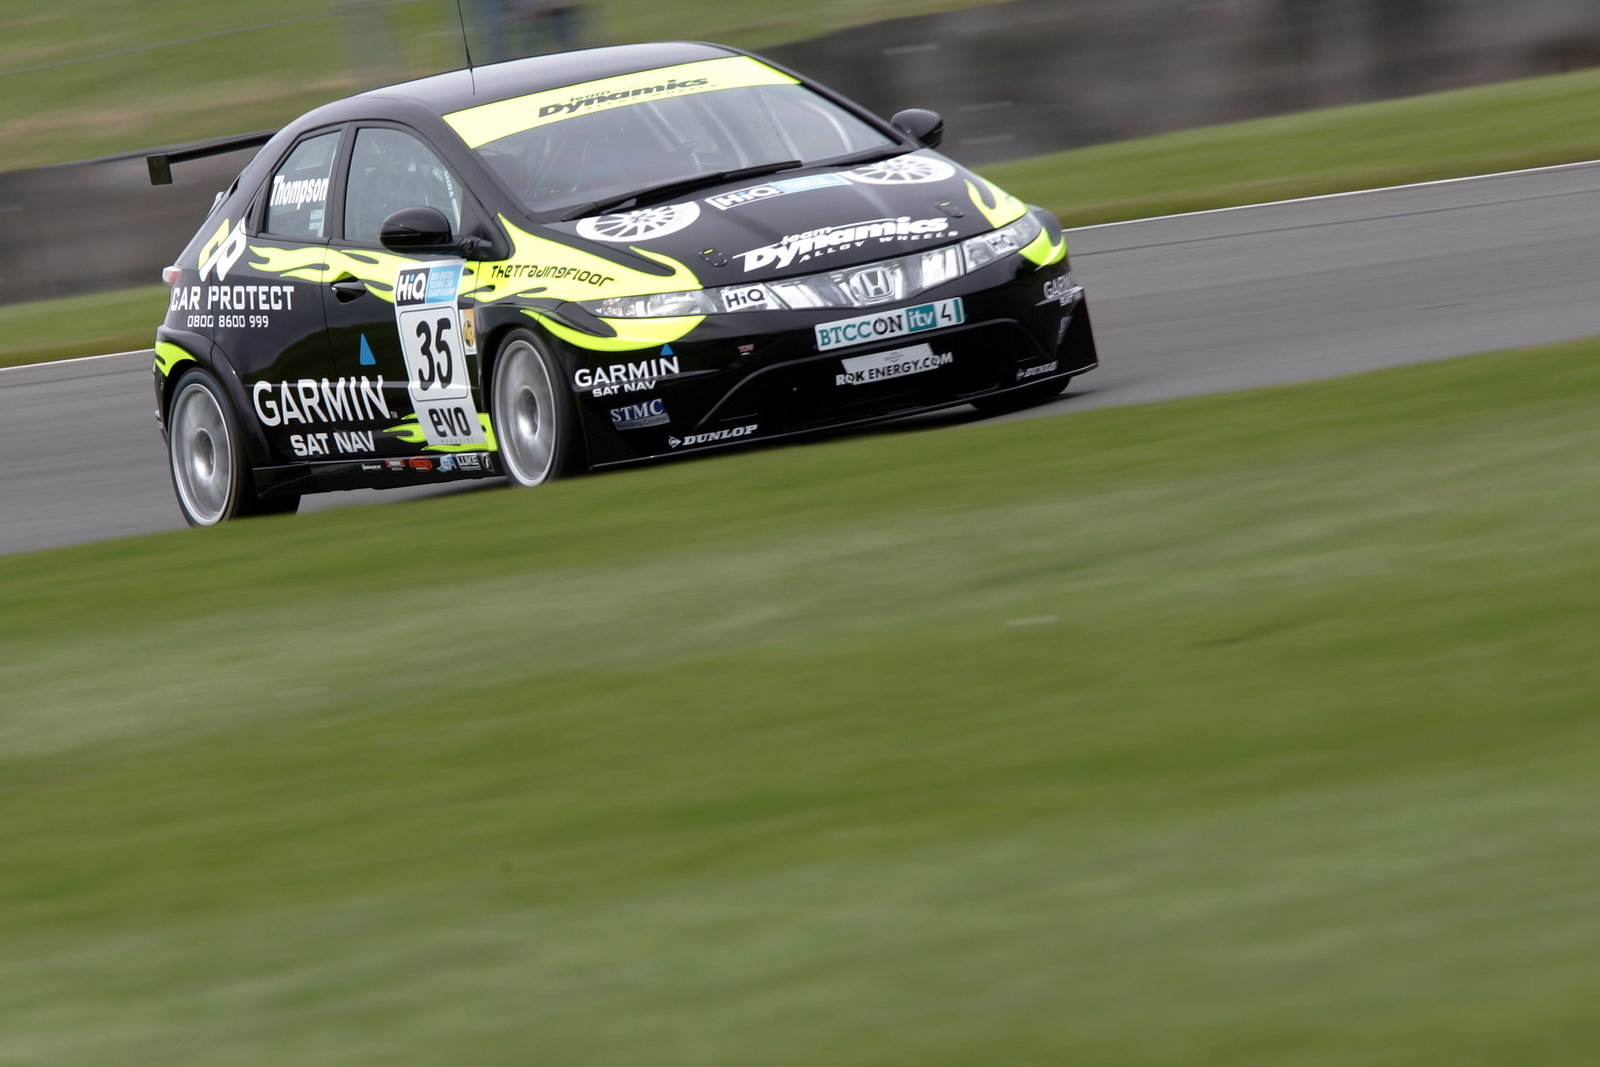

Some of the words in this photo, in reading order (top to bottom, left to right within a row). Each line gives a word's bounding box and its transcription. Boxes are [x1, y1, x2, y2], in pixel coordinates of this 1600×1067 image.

[538, 78, 709, 118] Dynamics
[270, 175, 328, 209] Thompson
[719, 186, 781, 207] HiQ
[732, 216, 950, 272] Dynamics
[780, 226, 833, 247] team
[799, 240, 866, 263] ALLOY
[879, 230, 959, 245] WHEELS
[170, 286, 201, 311] CAR
[207, 286, 295, 311] PROTECT
[397, 272, 427, 301] HiQ
[725, 288, 765, 309] HiQ
[187, 315, 214, 328] 0800
[219, 314, 246, 328] 8600
[249, 315, 270, 328] 999
[908, 310, 935, 329] itv
[940, 303, 953, 322] 4
[416, 317, 453, 392] 35
[574, 356, 680, 388] GARMIN
[835, 371, 866, 386] ROK
[868, 352, 954, 380] ENERGY.COM
[252, 374, 391, 427] GARMIN
[592, 384, 620, 398] SAT
[624, 380, 656, 394] NAV
[428, 406, 472, 438] evo
[610, 398, 664, 423] STMC
[290, 432, 330, 456] SAT
[333, 430, 376, 454] NAV
[683, 424, 759, 447] DUNLOP
